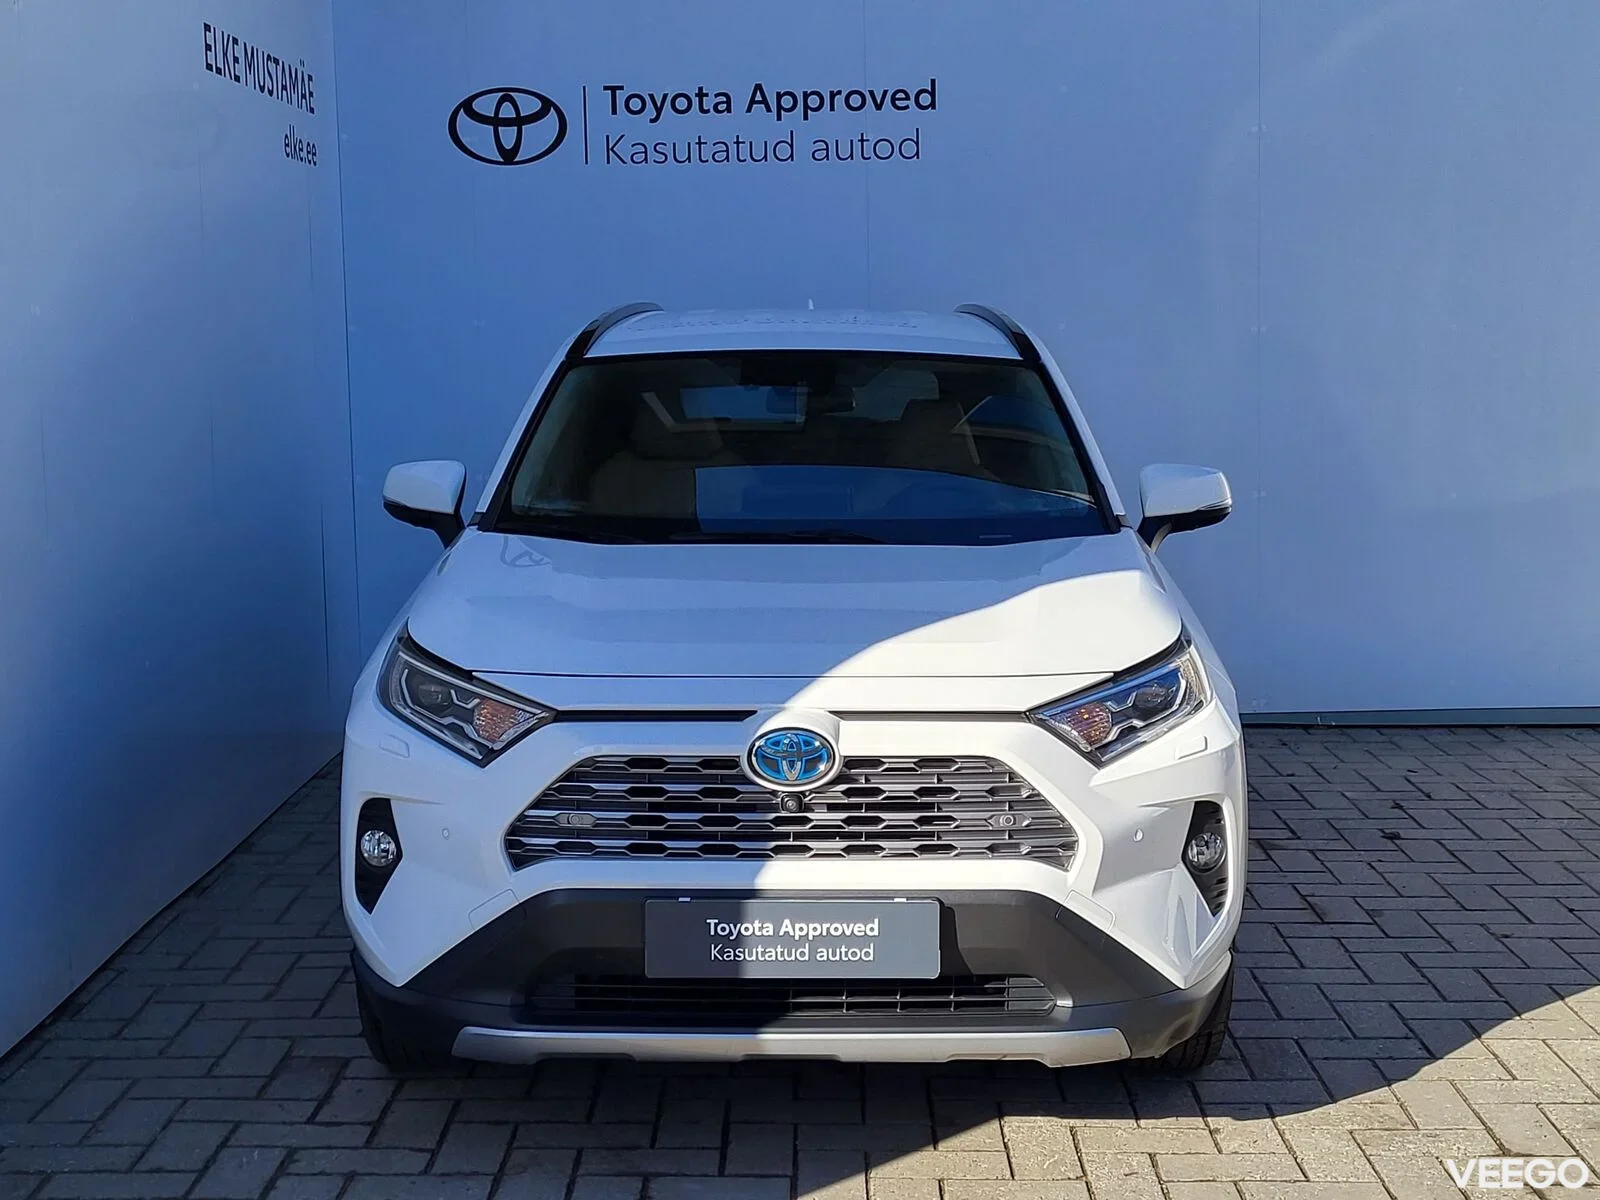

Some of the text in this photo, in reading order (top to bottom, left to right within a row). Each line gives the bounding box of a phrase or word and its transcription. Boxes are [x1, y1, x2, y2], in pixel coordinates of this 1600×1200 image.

[203, 22, 315, 114] ELKE MUSTAMÄE
[602, 78, 938, 123] Toyota Approved
[284, 124, 317, 166] elke.ee
[605, 128, 921, 165] Kasutatud autod
[706, 918, 880, 940] Toyota Approved
[711, 943, 874, 961] Kasutatud autod
